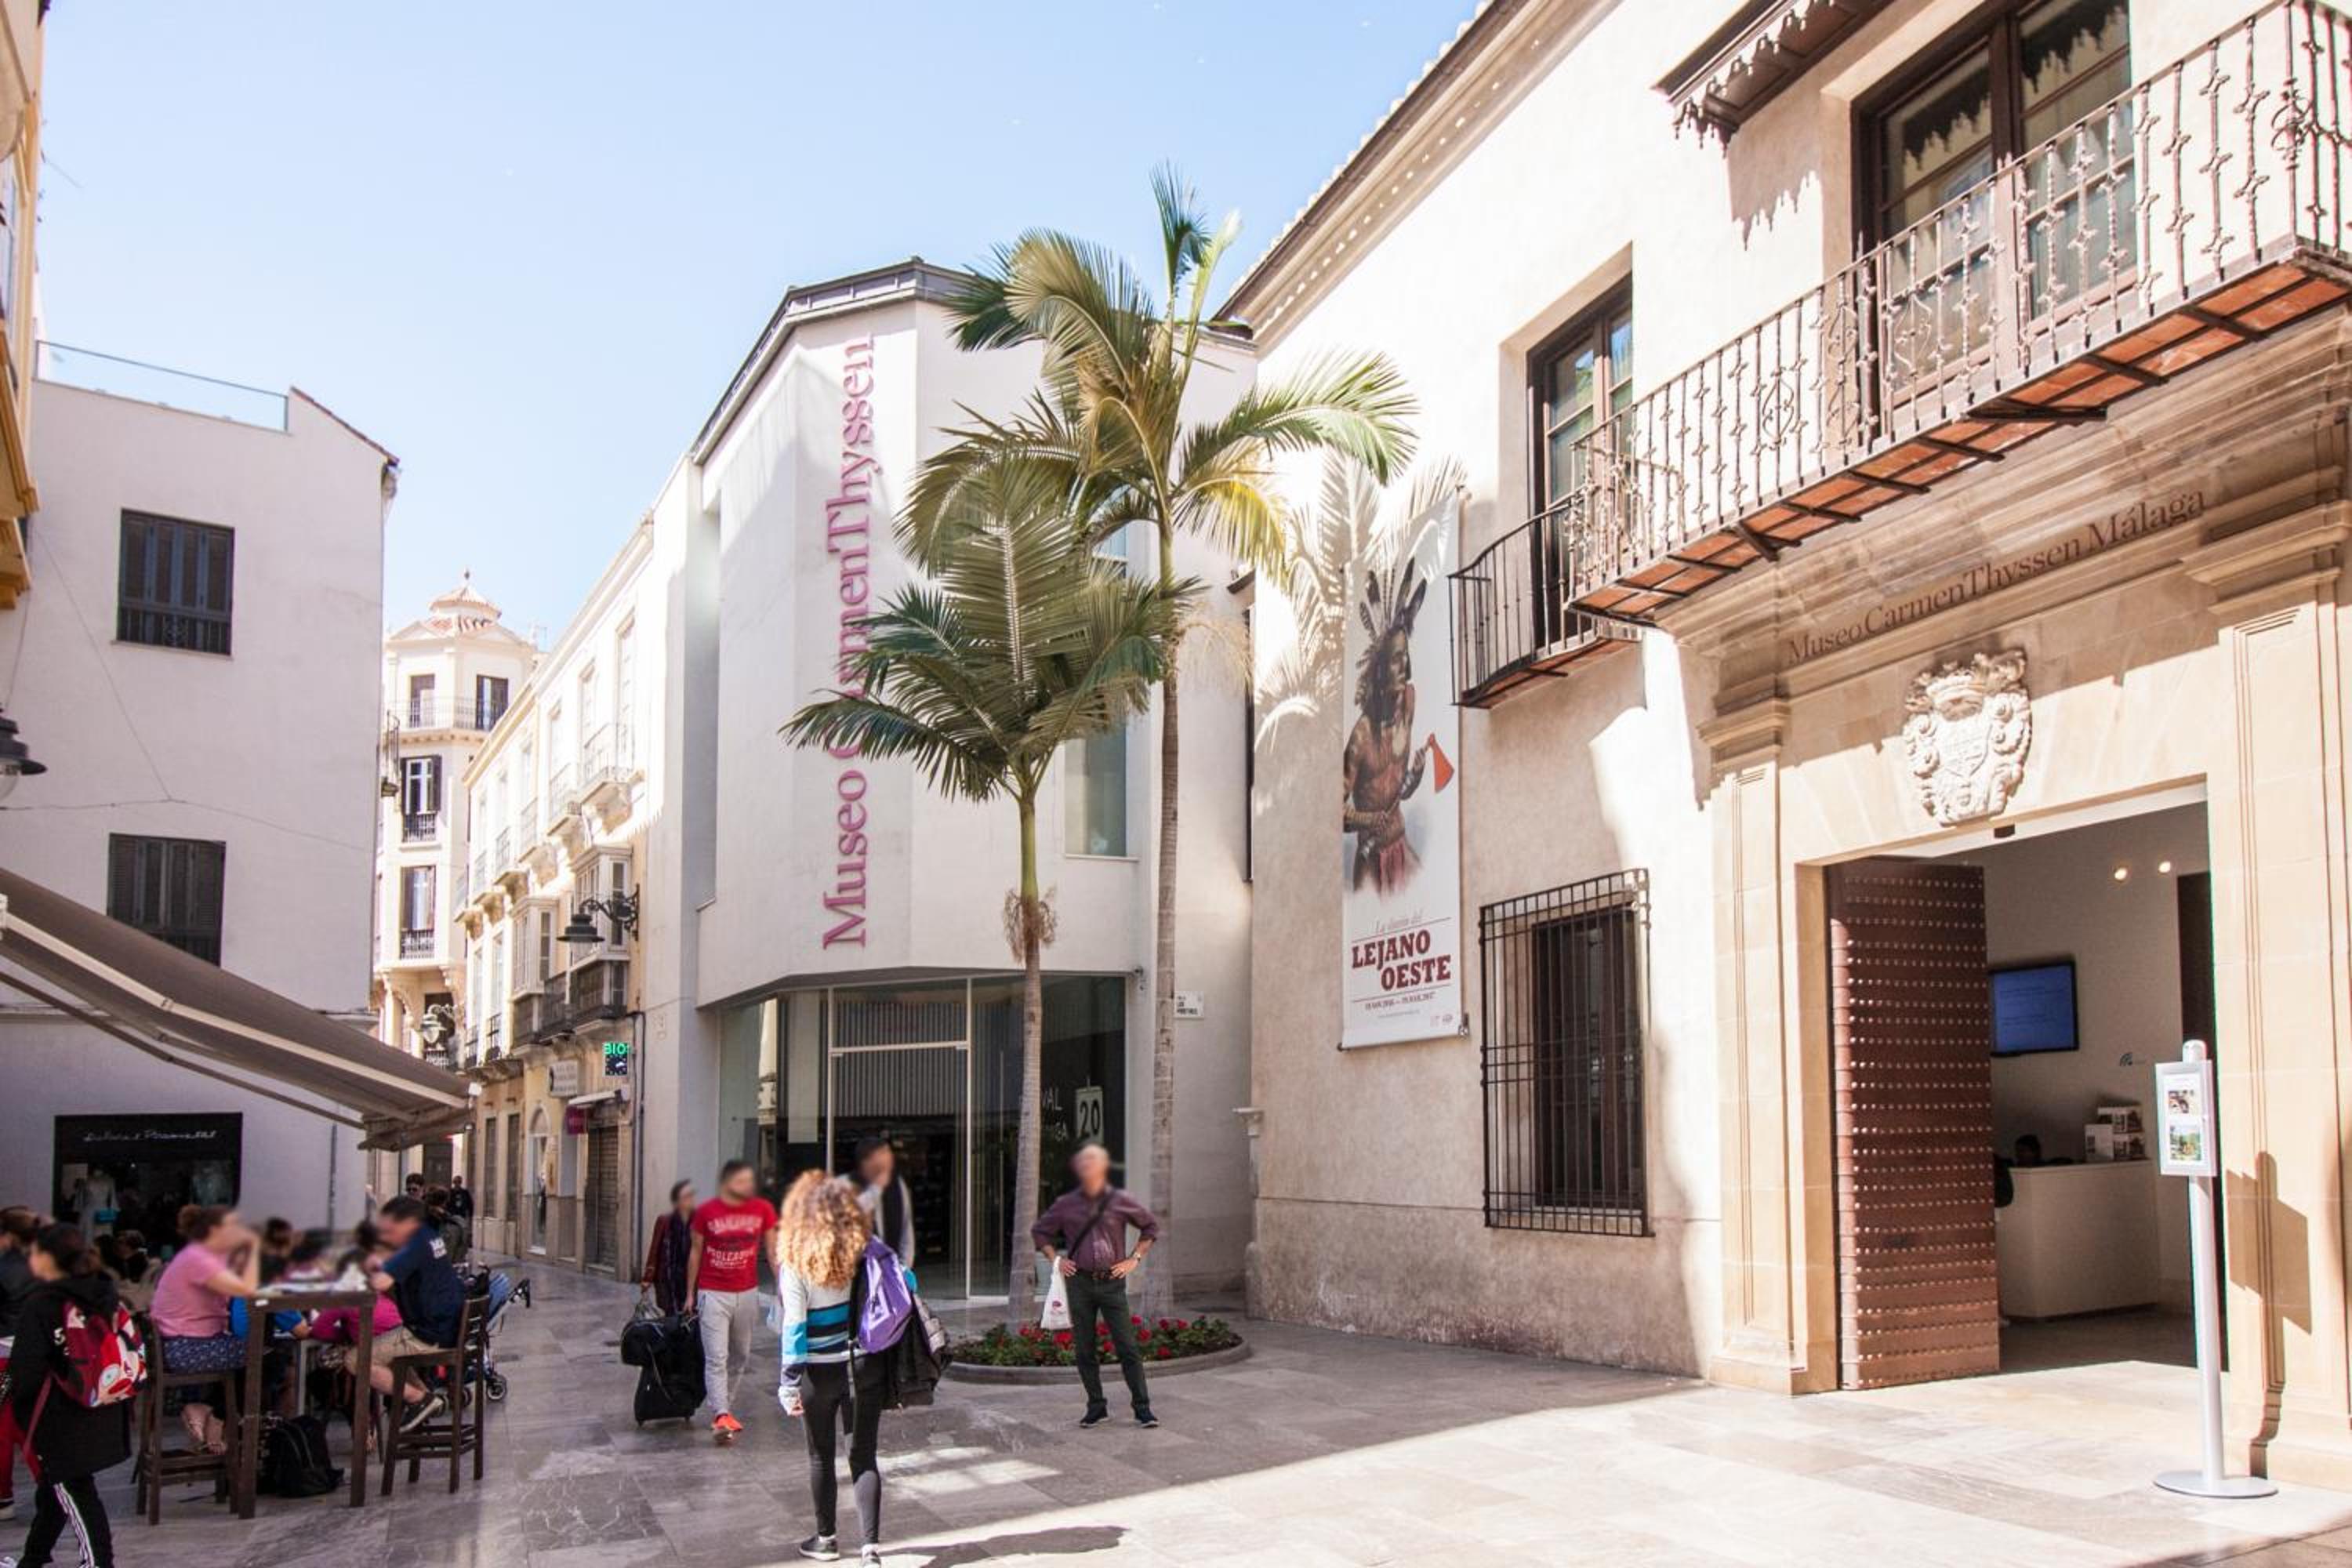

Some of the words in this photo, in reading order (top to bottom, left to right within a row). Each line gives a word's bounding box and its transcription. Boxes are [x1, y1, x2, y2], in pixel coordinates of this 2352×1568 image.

[1788, 622, 1862, 666] Museo
[2085, 490, 2205, 553] Málaga
[822, 769, 868, 950] Museo
[1352, 929, 1431, 971] LEJANO
[1381, 954, 1450, 992] OESTE
[1079, 1099, 1101, 1139] 20
